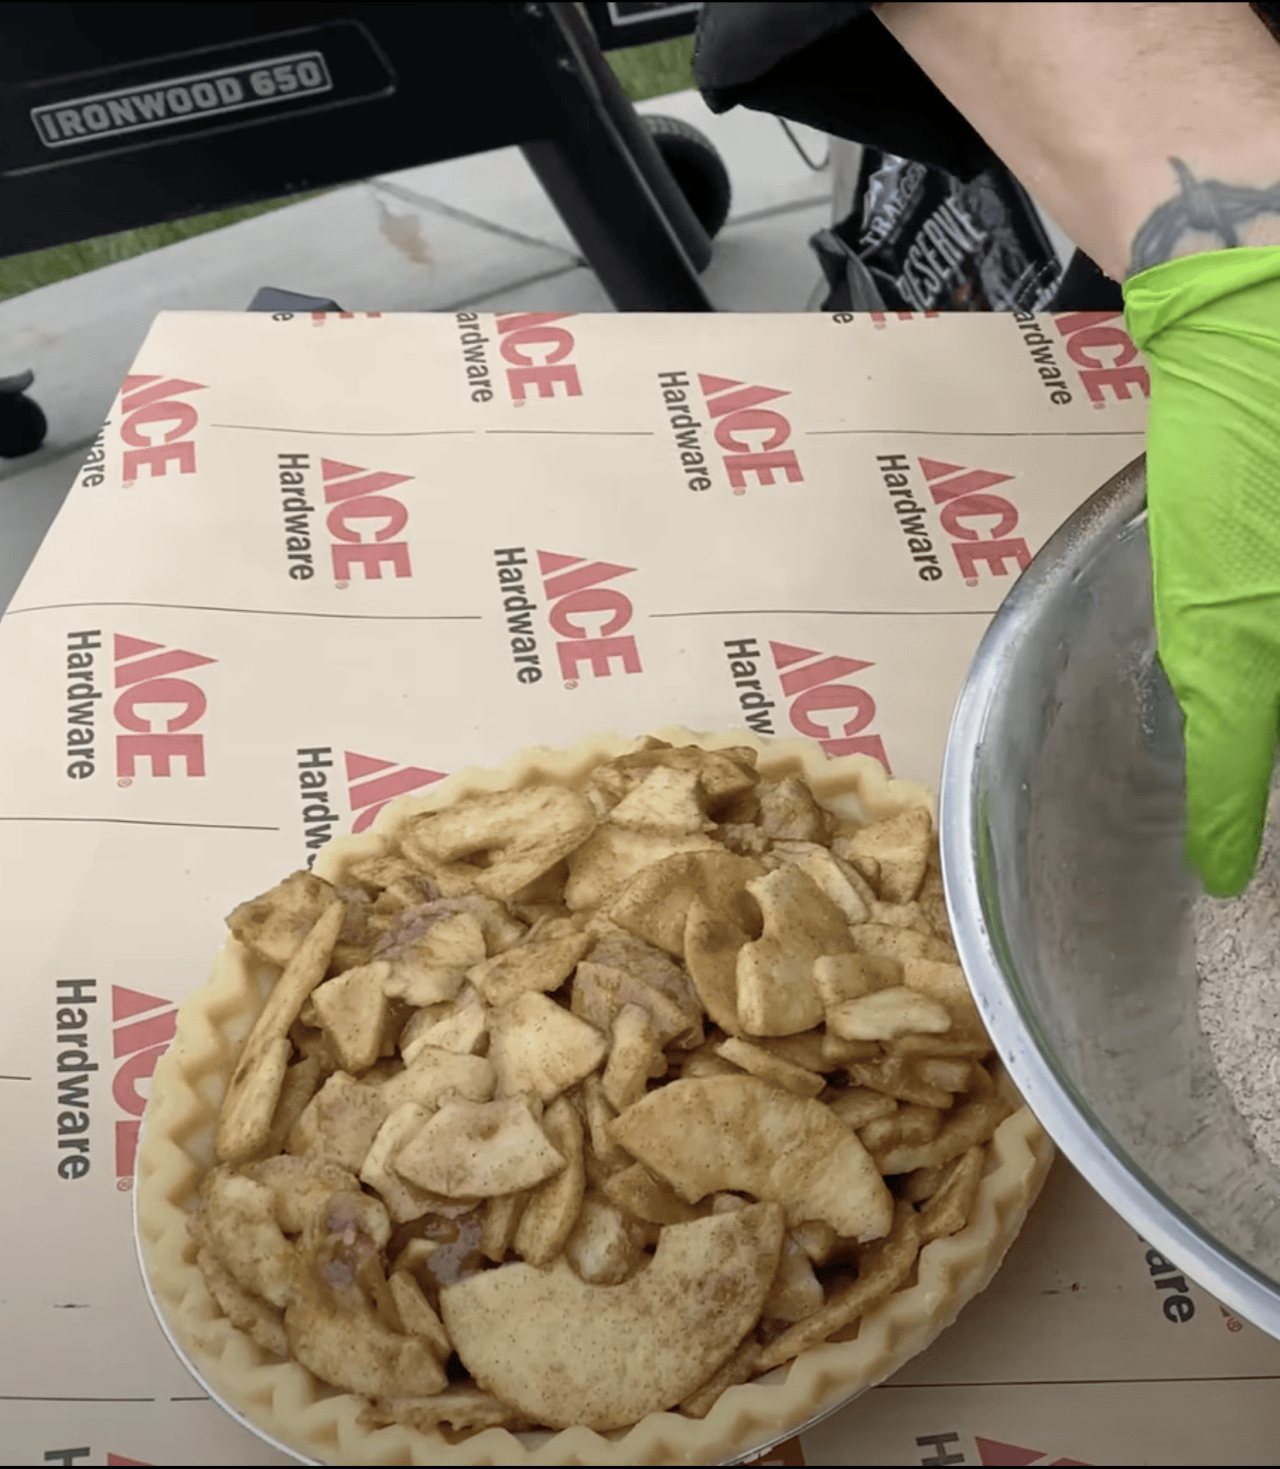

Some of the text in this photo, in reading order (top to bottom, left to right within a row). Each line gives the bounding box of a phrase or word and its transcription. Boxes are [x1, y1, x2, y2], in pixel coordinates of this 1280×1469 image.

[41, 60, 323, 140] IRONWOOD 650
[456, 312, 493, 403] ardware
[1013, 312, 1072, 405] ardware
[121, 374, 209, 481] ACE
[658, 370, 711, 492] Hardware
[697, 373, 805, 488] ACE
[277, 453, 315, 581] Hardware
[320, 457, 416, 580] ACE
[876, 453, 943, 582] Hardware
[917, 457, 1033, 580] ACE
[494, 547, 543, 685] Hardware
[536, 549, 643, 681] ACE
[67, 629, 102, 780] Hardware
[113, 633, 219, 778] ACE
[723, 638, 776, 735] Hardw
[297, 747, 339, 871] Hardw
[56, 978, 99, 1180] Hardware
